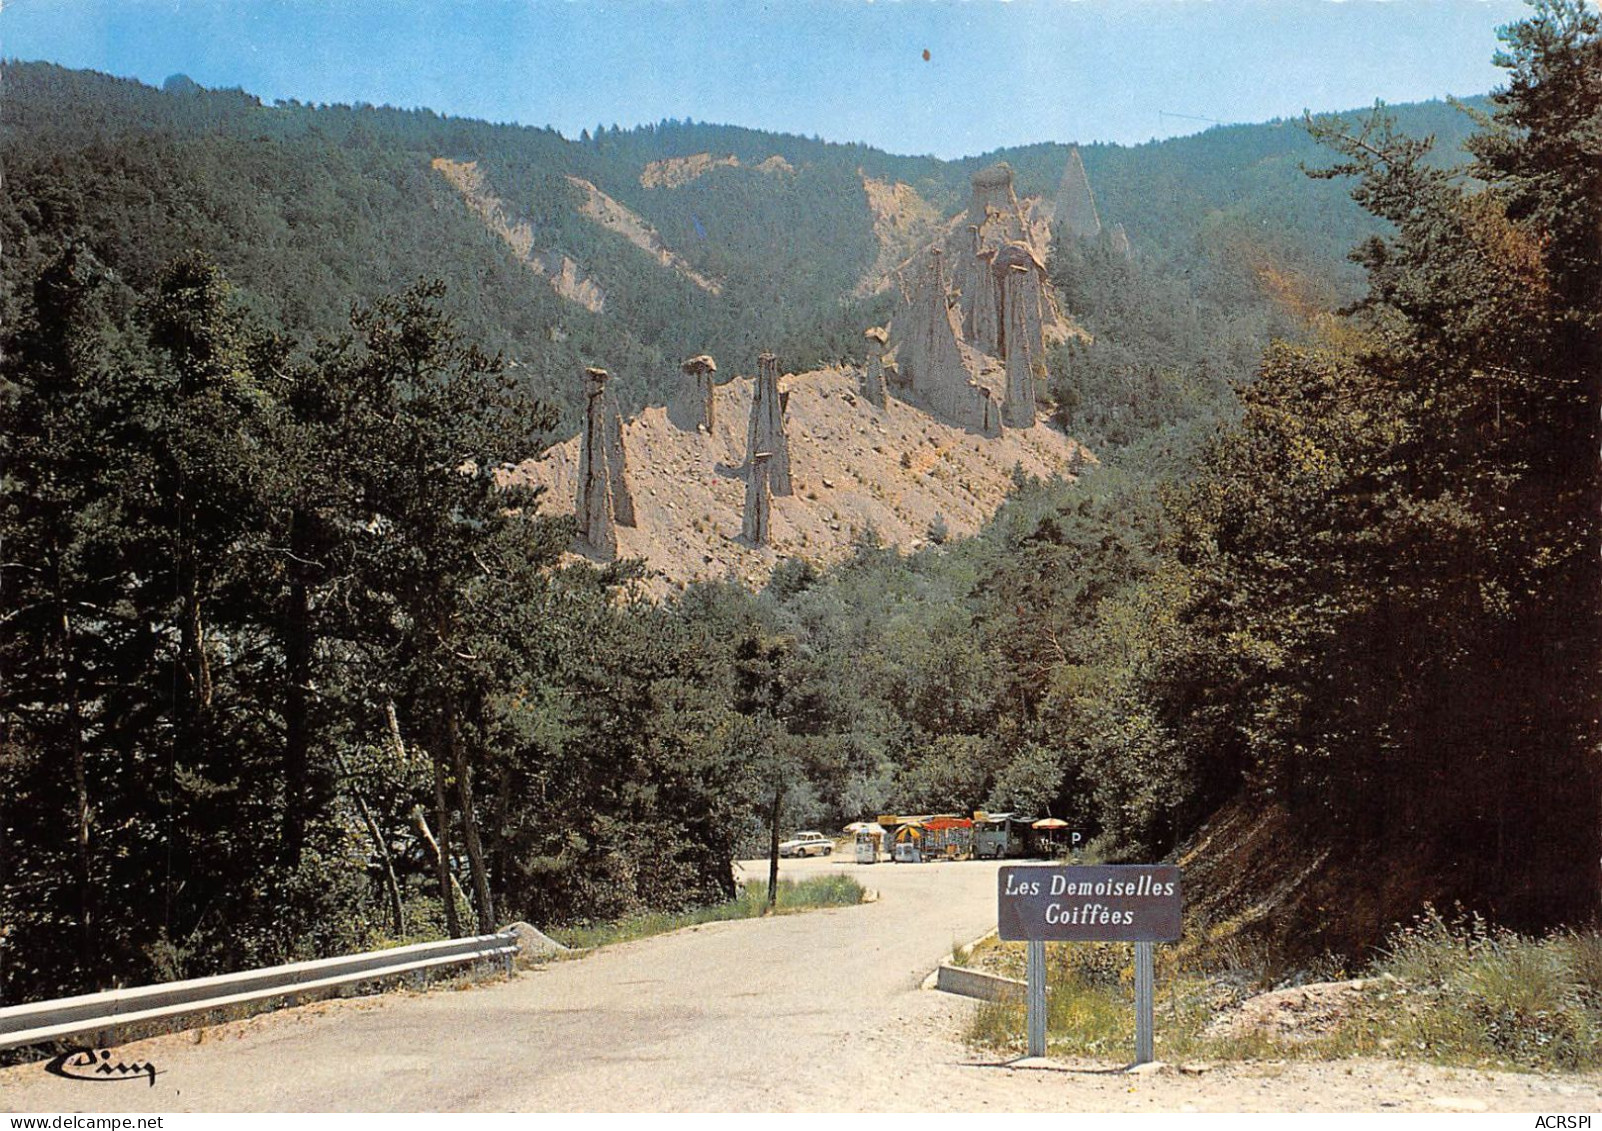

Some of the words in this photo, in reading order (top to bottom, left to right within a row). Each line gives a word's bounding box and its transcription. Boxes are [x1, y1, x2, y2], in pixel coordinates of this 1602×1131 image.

[1072, 832, 1081, 844] P
[1005, 874, 1040, 895] Les
[1050, 875, 1174, 896] Demoiselles
[1045, 903, 1134, 925] Coiffées
